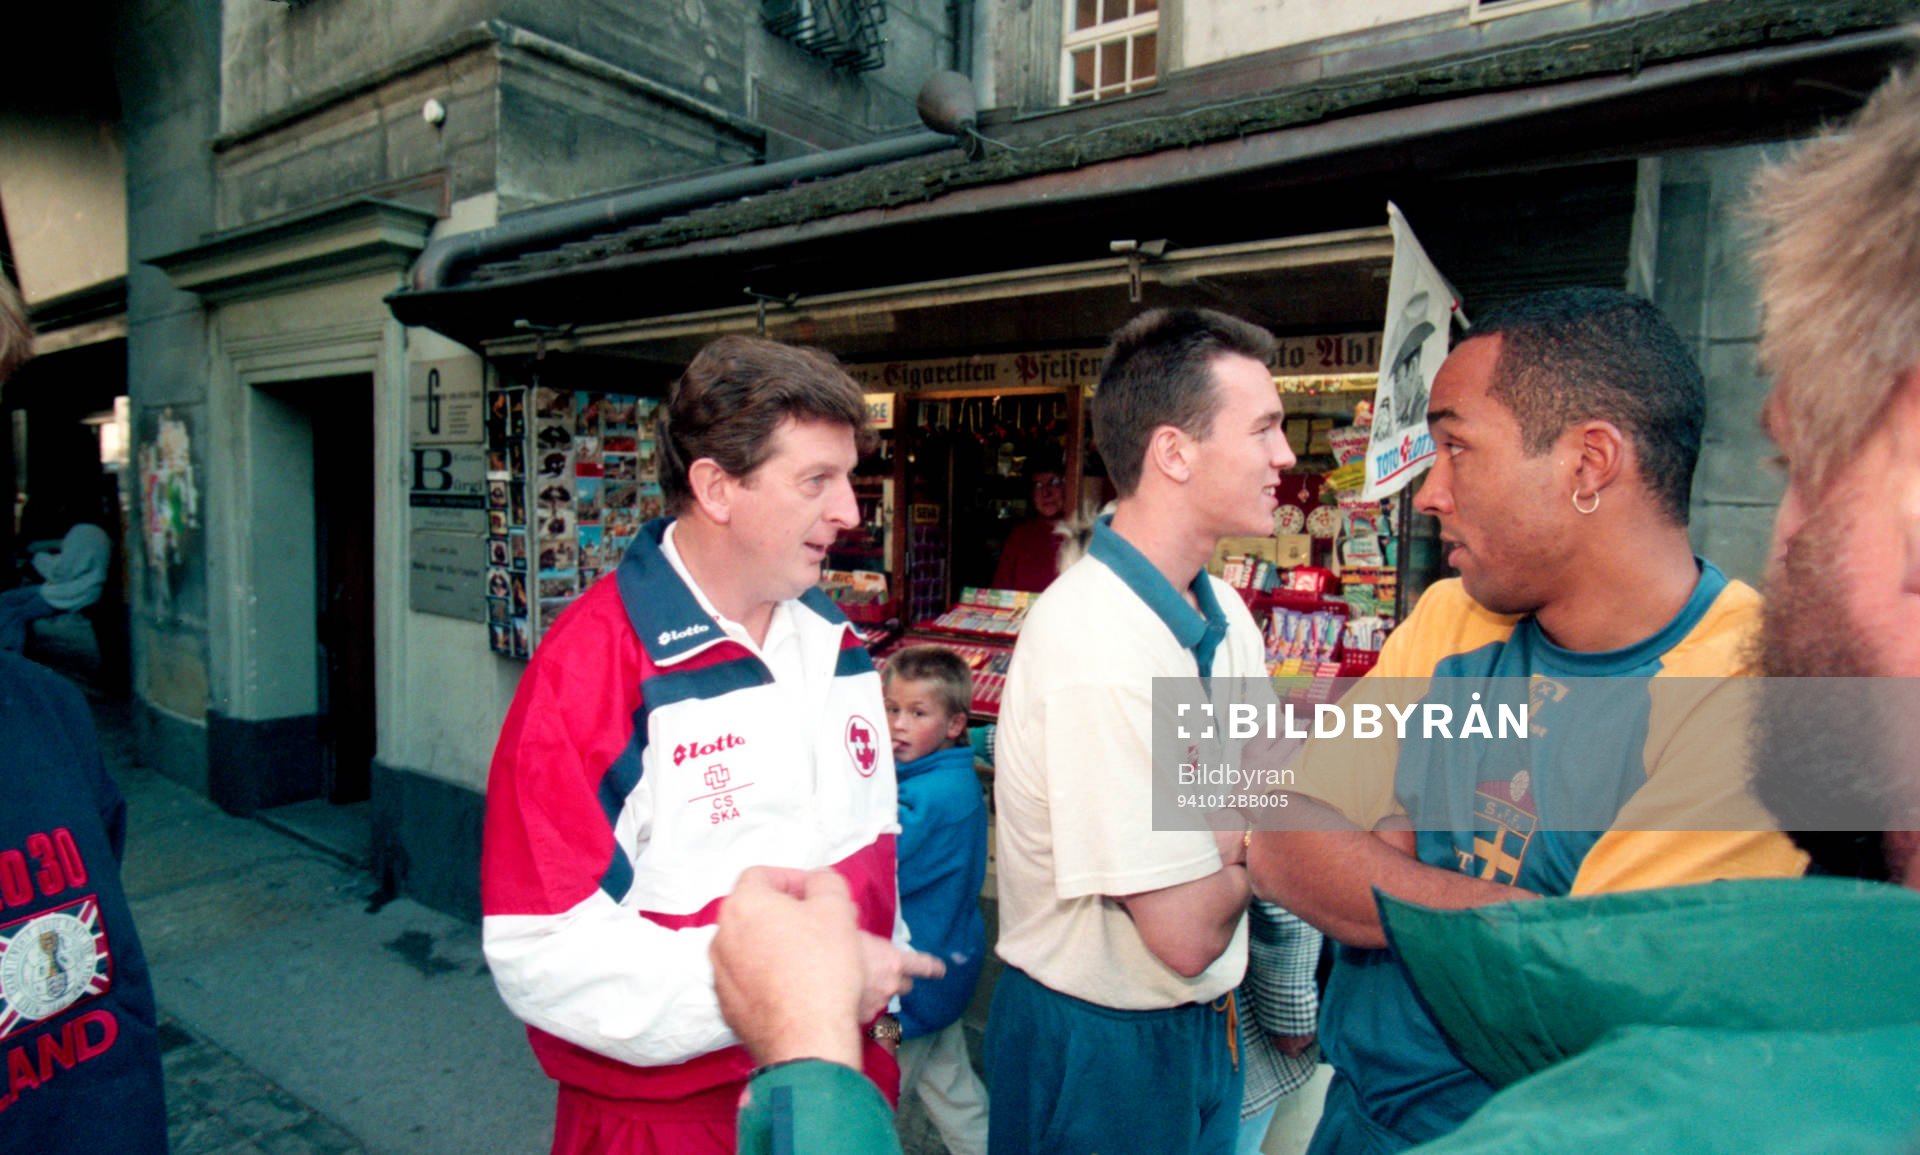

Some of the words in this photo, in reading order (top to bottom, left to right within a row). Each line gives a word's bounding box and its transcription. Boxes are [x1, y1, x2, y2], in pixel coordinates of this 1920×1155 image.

[1376, 447, 1399, 478] TOTO
[670, 624, 709, 641] lotto
[689, 733, 746, 758] lotto
[713, 795, 734, 810] CS
[710, 808, 741, 825] SKA
[26, 826, 88, 896] 30
